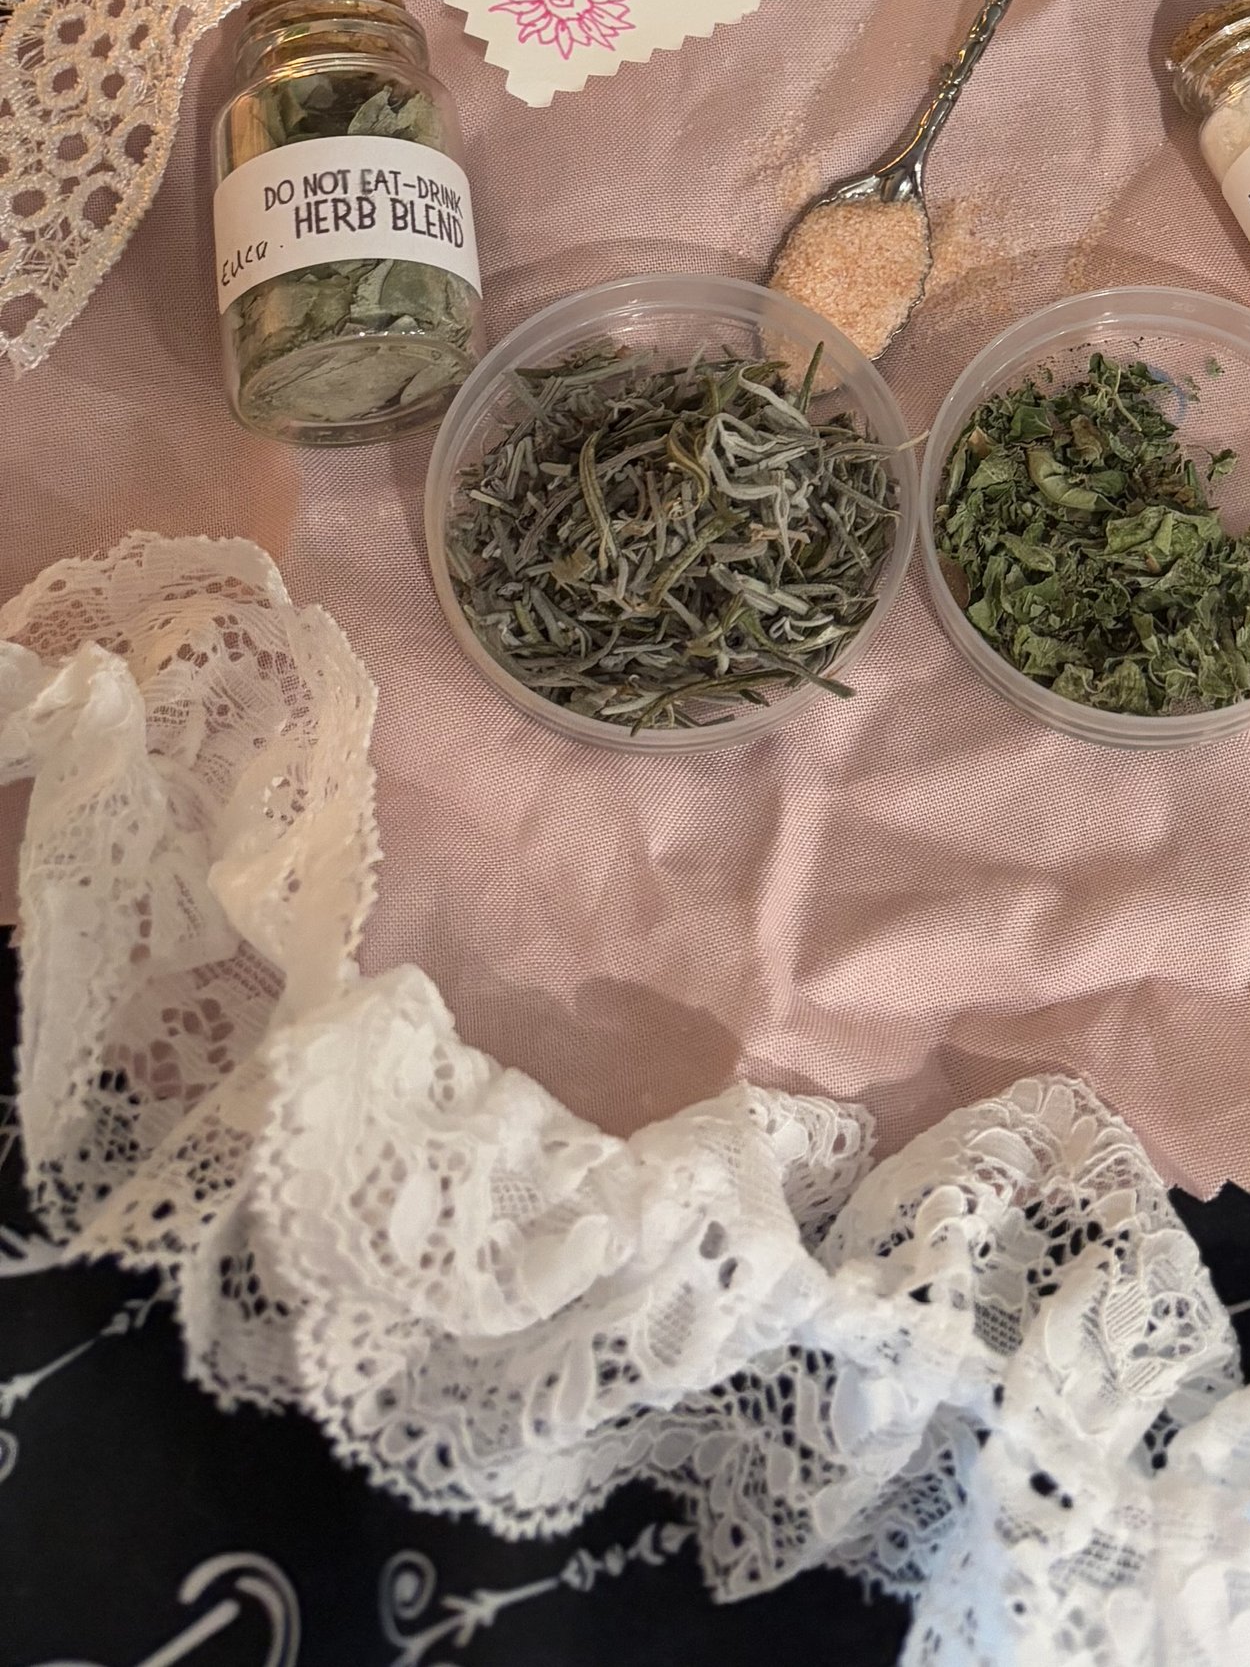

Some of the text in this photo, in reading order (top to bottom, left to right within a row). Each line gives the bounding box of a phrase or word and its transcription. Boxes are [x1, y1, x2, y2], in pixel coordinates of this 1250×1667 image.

[264, 168, 464, 220] DO NOT EAT-DRINK
[294, 196, 464, 248] HERB BLEND
